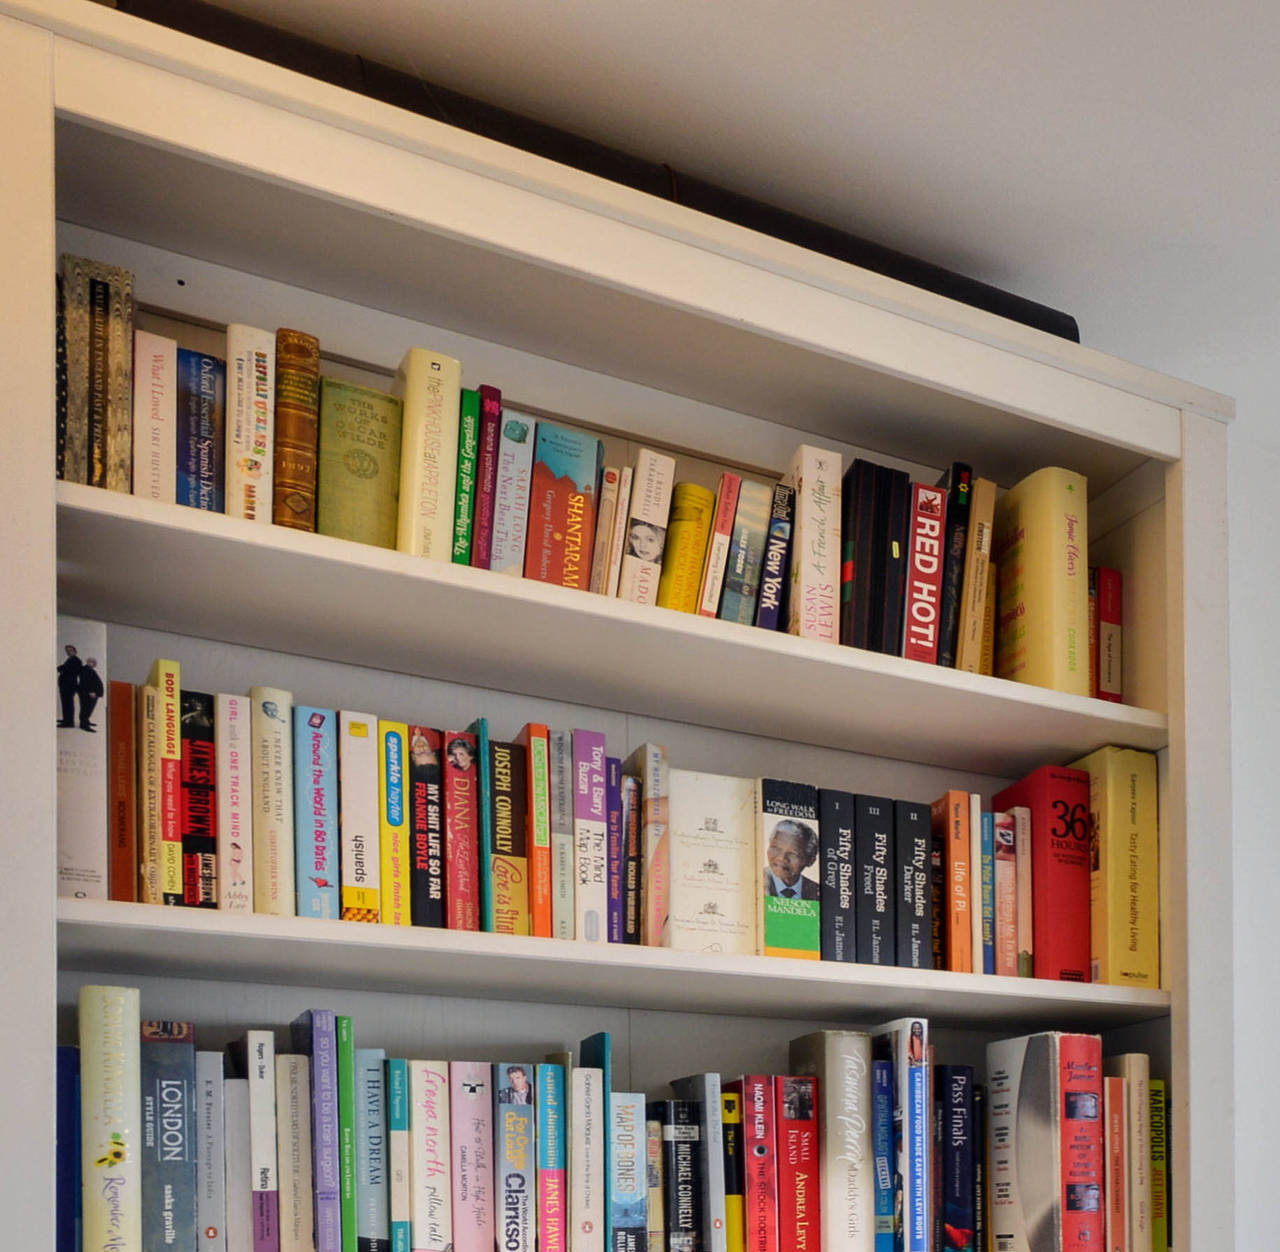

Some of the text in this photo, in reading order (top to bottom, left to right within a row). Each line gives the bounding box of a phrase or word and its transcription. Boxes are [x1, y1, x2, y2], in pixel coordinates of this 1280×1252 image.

[152, 390, 164, 422] Loved
[196, 358, 214, 477] Oxford Spanish
[500, 475, 515, 500] Next
[511, 468, 529, 553] SARAH LONG
[562, 493, 585, 588] SHANTARAM
[761, 538, 786, 610] New York
[911, 517, 940, 648] RED HOT!
[805, 585, 817, 631] SUSAN
[818, 584, 834, 640] LEWIS
[164, 672, 175, 756] BODY LANGUAGE
[188, 741, 212, 837] JAMES BROWN
[228, 699, 240, 838] GIRL ONE TRACK MIND
[262, 771, 270, 814] ENGLAND
[273, 738, 284, 823] NEVER THAT
[387, 736, 400, 822] sparkle hayter
[495, 746, 513, 853] JOSEPH CONNOLLY
[578, 761, 591, 794] Buzan
[311, 732, 326, 871] Around Dates
[415, 782, 428, 870] FRANKIE BOYLE
[453, 777, 470, 831] DIANA
[1051, 799, 1089, 842] 36
[166, 843, 175, 865] DAVID
[351, 835, 367, 883] spanish
[428, 784, 441, 899] MY SHIT LIFE SO FAR
[578, 828, 591, 886] Map Book
[837, 828, 852, 909] Fifty Shades
[874, 832, 887, 913] Fifty Shades
[392, 881, 401, 909] finish
[825, 860, 837, 888] Grey
[863, 865, 874, 894] Freed
[903, 865, 914, 903] Darker
[913, 838, 926, 917] Fifty Shades
[954, 861, 967, 912] Life of Pi
[1128, 895, 1140, 952] Healthy Living
[161, 1079, 182, 1161] LONDON
[367, 1079, 382, 1185] HAVE DREAM
[754, 1083, 764, 1139] NAOMI KLEIN
[951, 1075, 968, 1146] Pass Finals
[1150, 1089, 1164, 1162] NARCOPOLIS
[259, 1167, 271, 1188] Retina
[425, 1125, 446, 1177] north
[459, 1145, 468, 1201] CAMILLA MORTON
[616, 1104, 635, 1192] MAP BONES
[787, 1129, 799, 1164] ISLAND
[800, 1131, 811, 1161] SMALL
[545, 1177, 560, 1214] JAMES
[677, 1143, 693, 1228] MICHAEL CONNELLY
[795, 1170, 809, 1249] ANDREA LEVY
